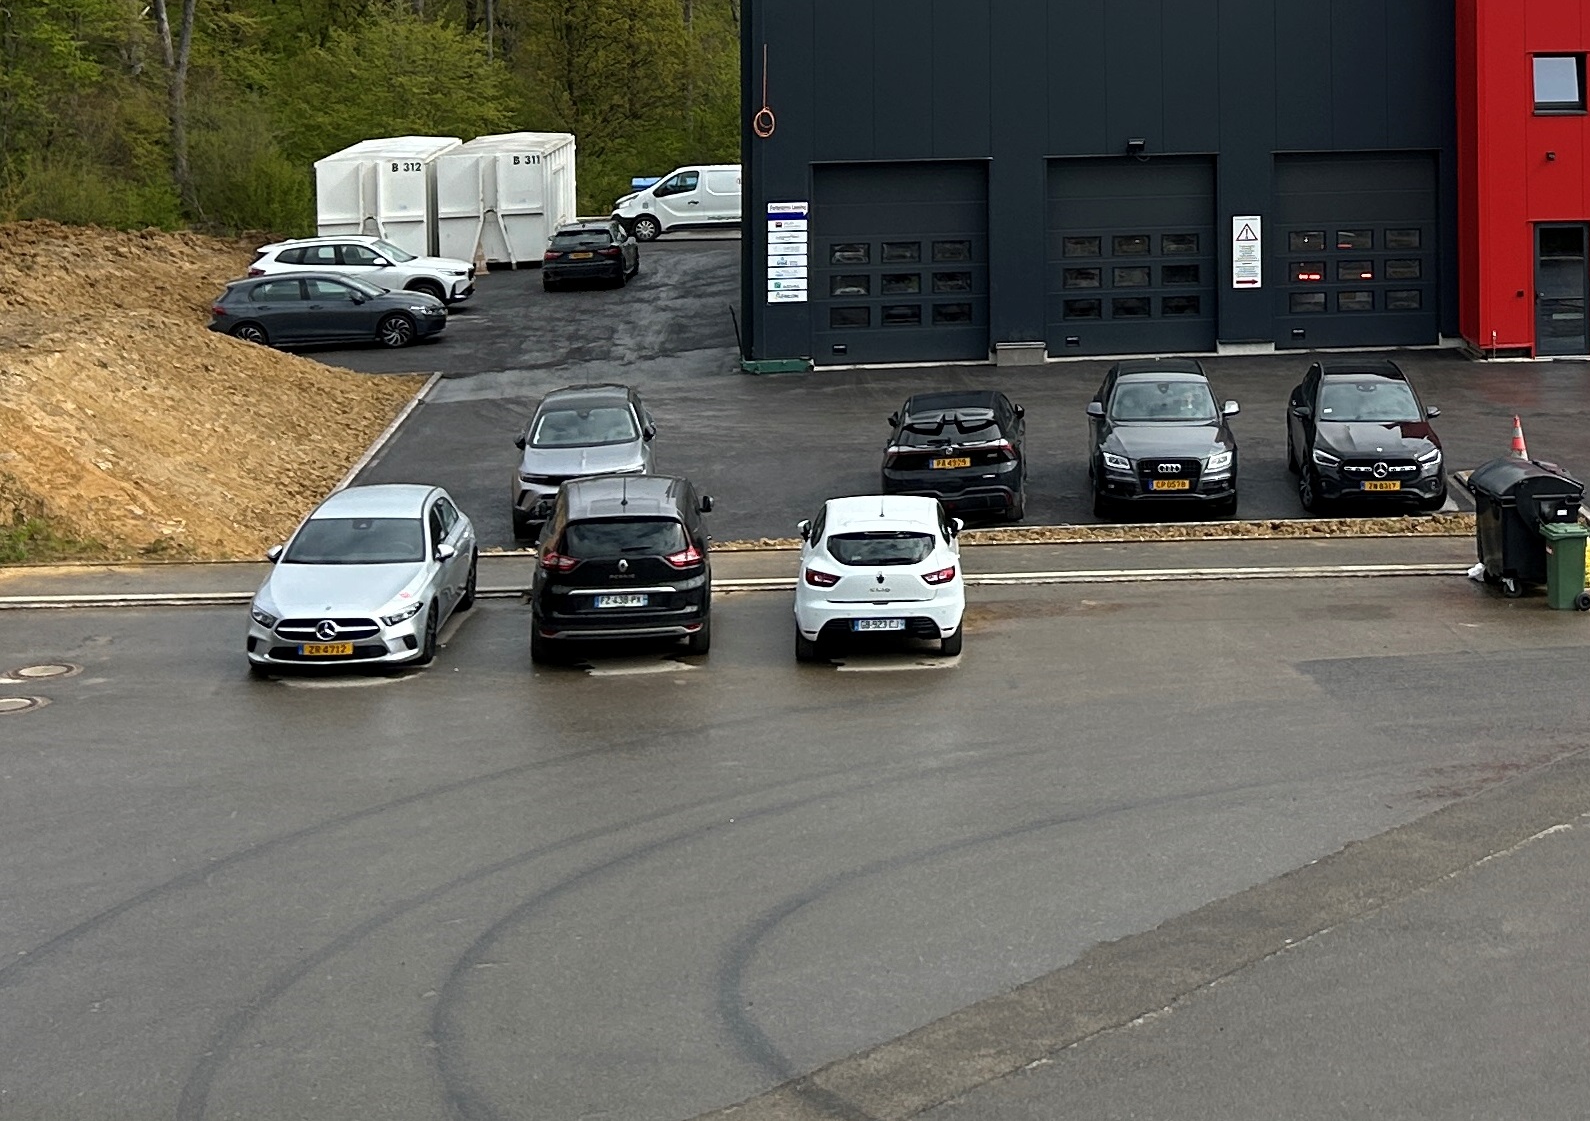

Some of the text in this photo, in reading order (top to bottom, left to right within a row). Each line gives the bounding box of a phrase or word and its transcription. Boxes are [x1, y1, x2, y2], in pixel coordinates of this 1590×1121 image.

[513, 155, 541, 165] B 311
[391, 162, 422, 172] B 312
[308, 644, 347, 655] ZR 4712
